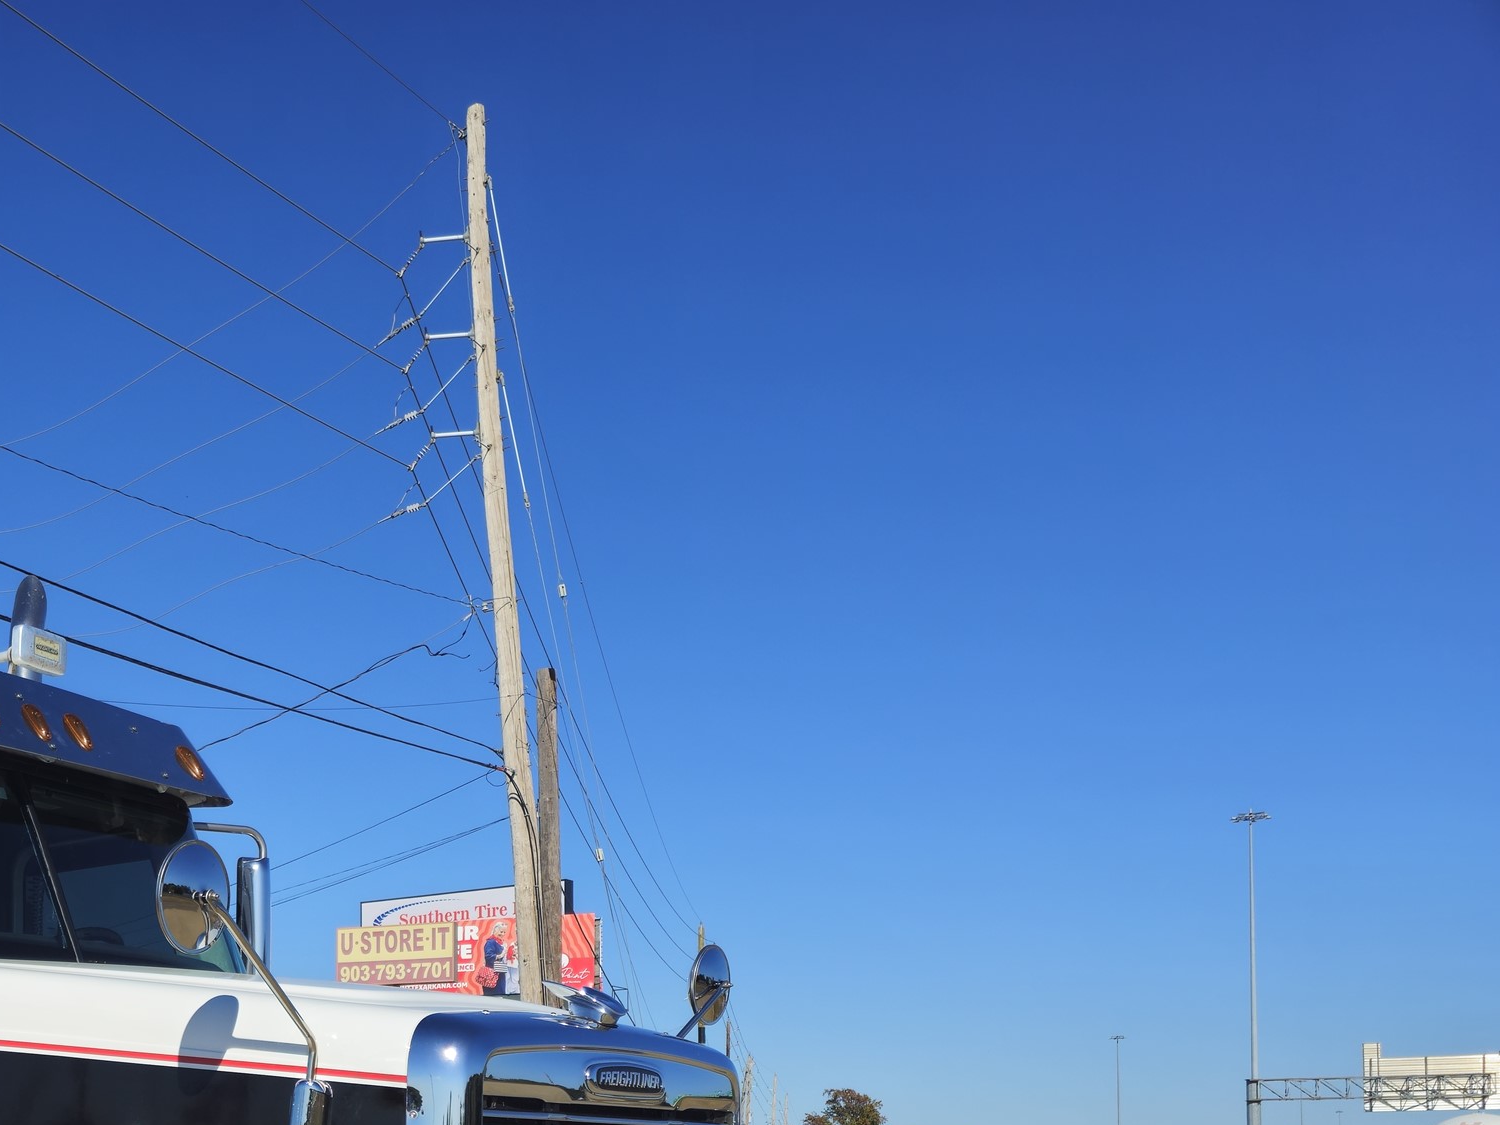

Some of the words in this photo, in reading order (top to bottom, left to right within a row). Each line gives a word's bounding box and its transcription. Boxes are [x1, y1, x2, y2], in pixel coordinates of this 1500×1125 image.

[399, 909, 470, 925] Southern
[475, 903, 507, 919] Tire
[599, 1071, 660, 1089] FREIGHTLINER
